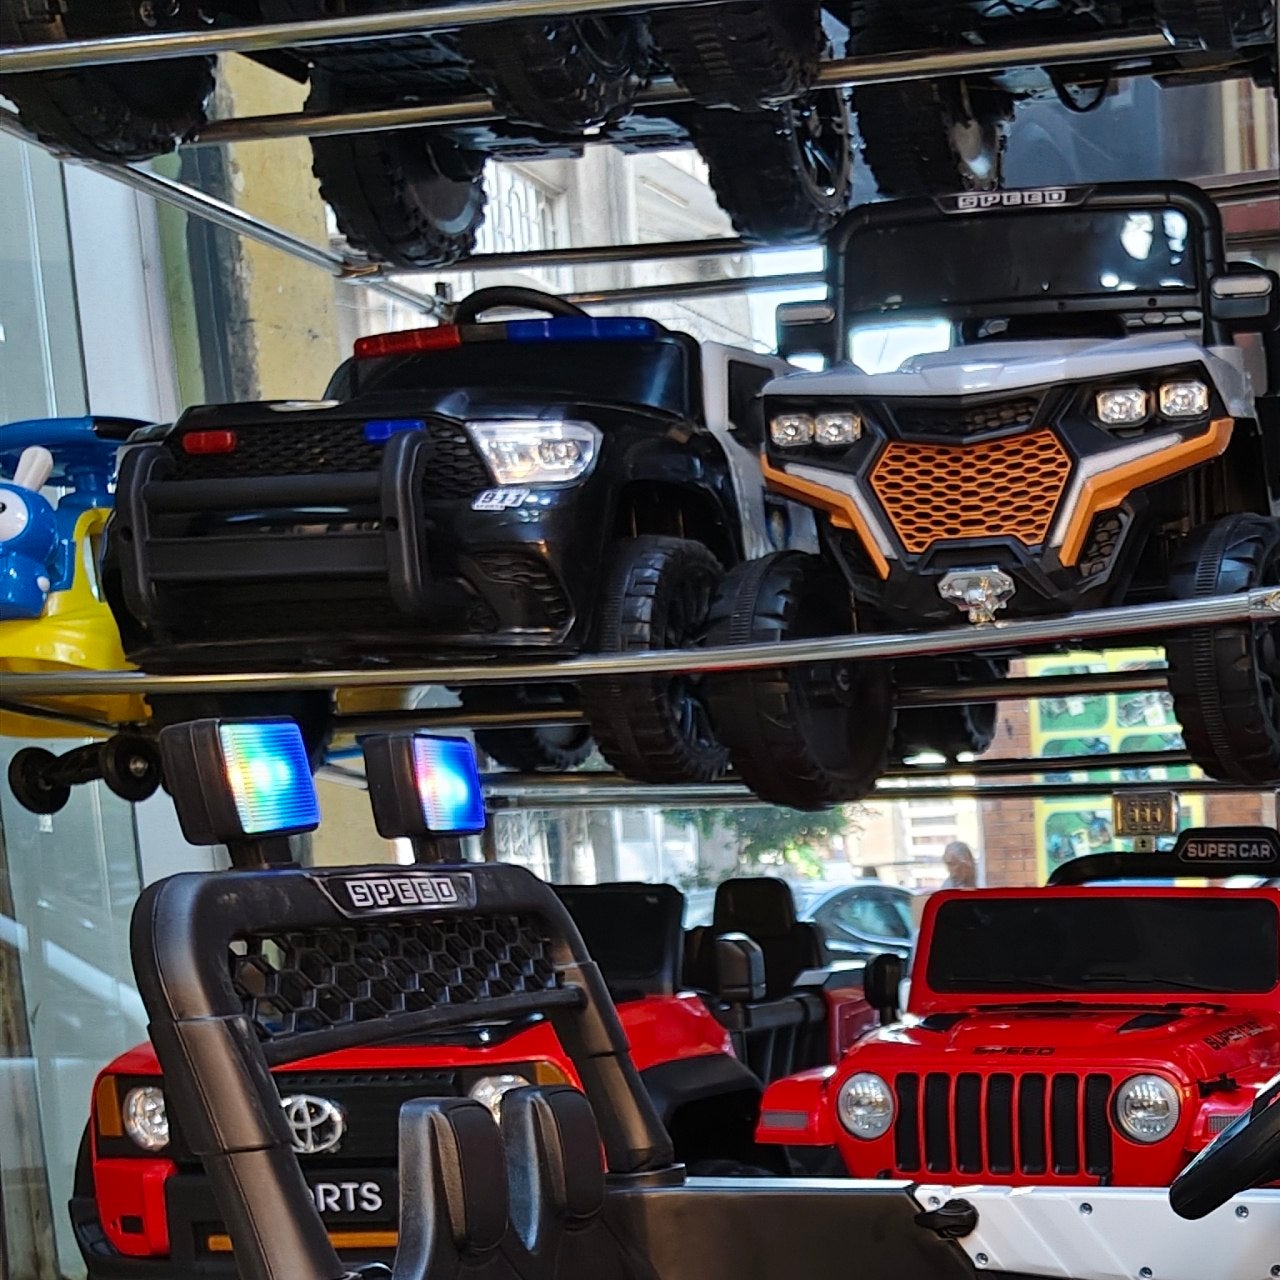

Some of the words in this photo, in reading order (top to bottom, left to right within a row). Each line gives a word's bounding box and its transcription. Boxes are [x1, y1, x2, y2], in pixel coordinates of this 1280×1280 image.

[957, 189, 1067, 210] SPEED
[1187, 843, 1237, 858] SUPER
[1239, 843, 1271, 858] CAR
[345, 878, 458, 907] SPEED
